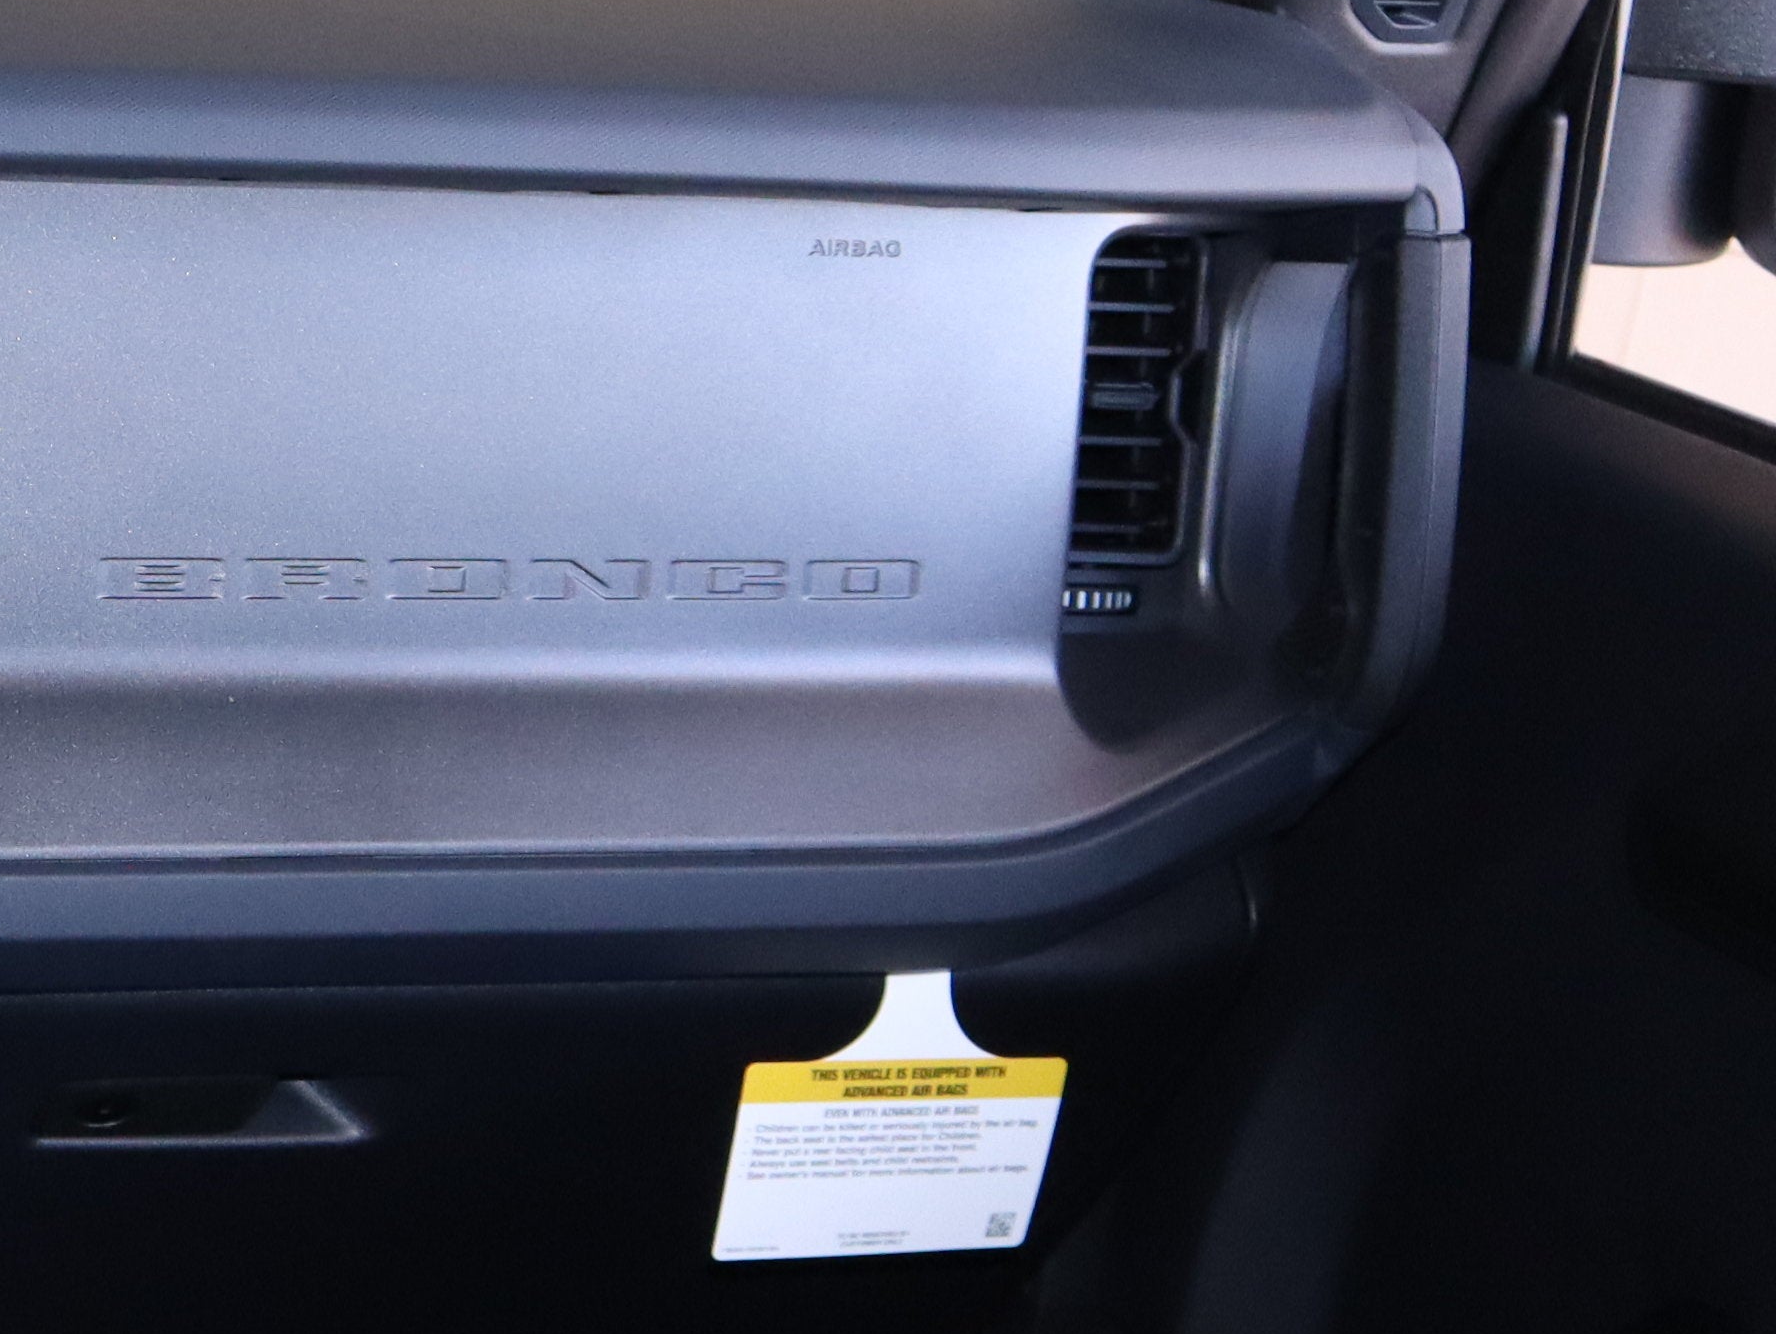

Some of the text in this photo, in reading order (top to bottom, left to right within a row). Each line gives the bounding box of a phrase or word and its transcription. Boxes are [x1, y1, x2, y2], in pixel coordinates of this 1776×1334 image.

[808, 238, 902, 258] AIRBAG
[97, 556, 921, 601] BRONCO
[811, 1069, 839, 1081] THIS
[843, 1068, 893, 1081] VEHICLE
[896, 1068, 907, 1079] IS
[976, 1066, 1007, 1077] WITH
[843, 1085, 908, 1097] ADVANCED
